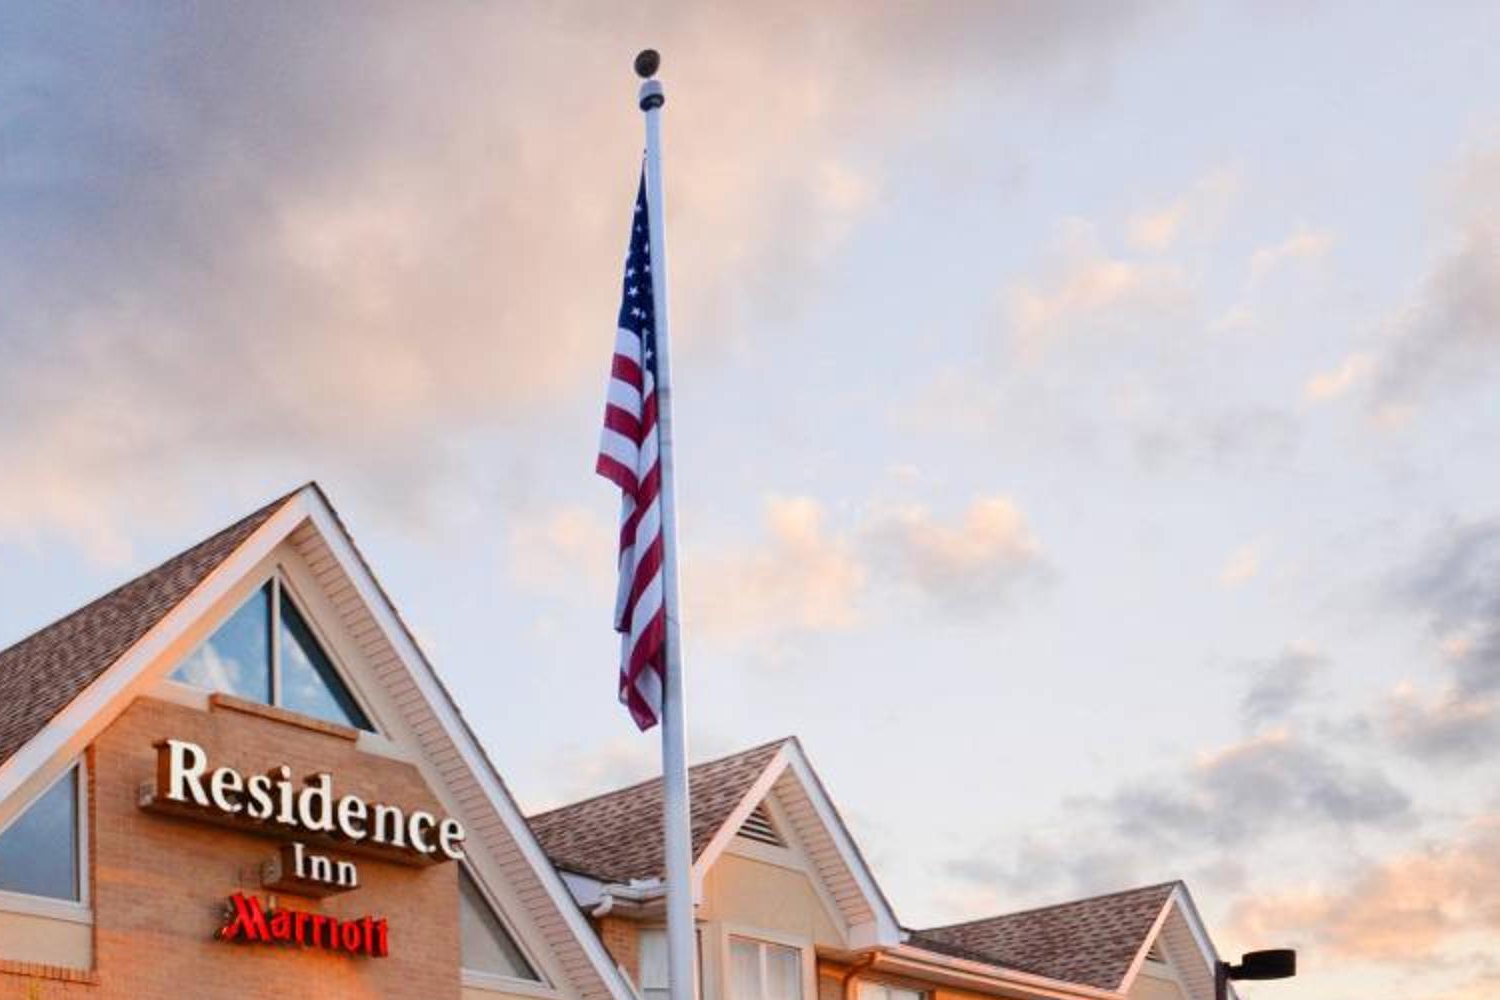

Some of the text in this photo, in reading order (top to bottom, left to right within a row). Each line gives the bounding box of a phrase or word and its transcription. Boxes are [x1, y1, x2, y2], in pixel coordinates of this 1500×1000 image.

[167, 739, 466, 858] Residence
[293, 842, 357, 887] Inn
[219, 891, 389, 958] Marriott
